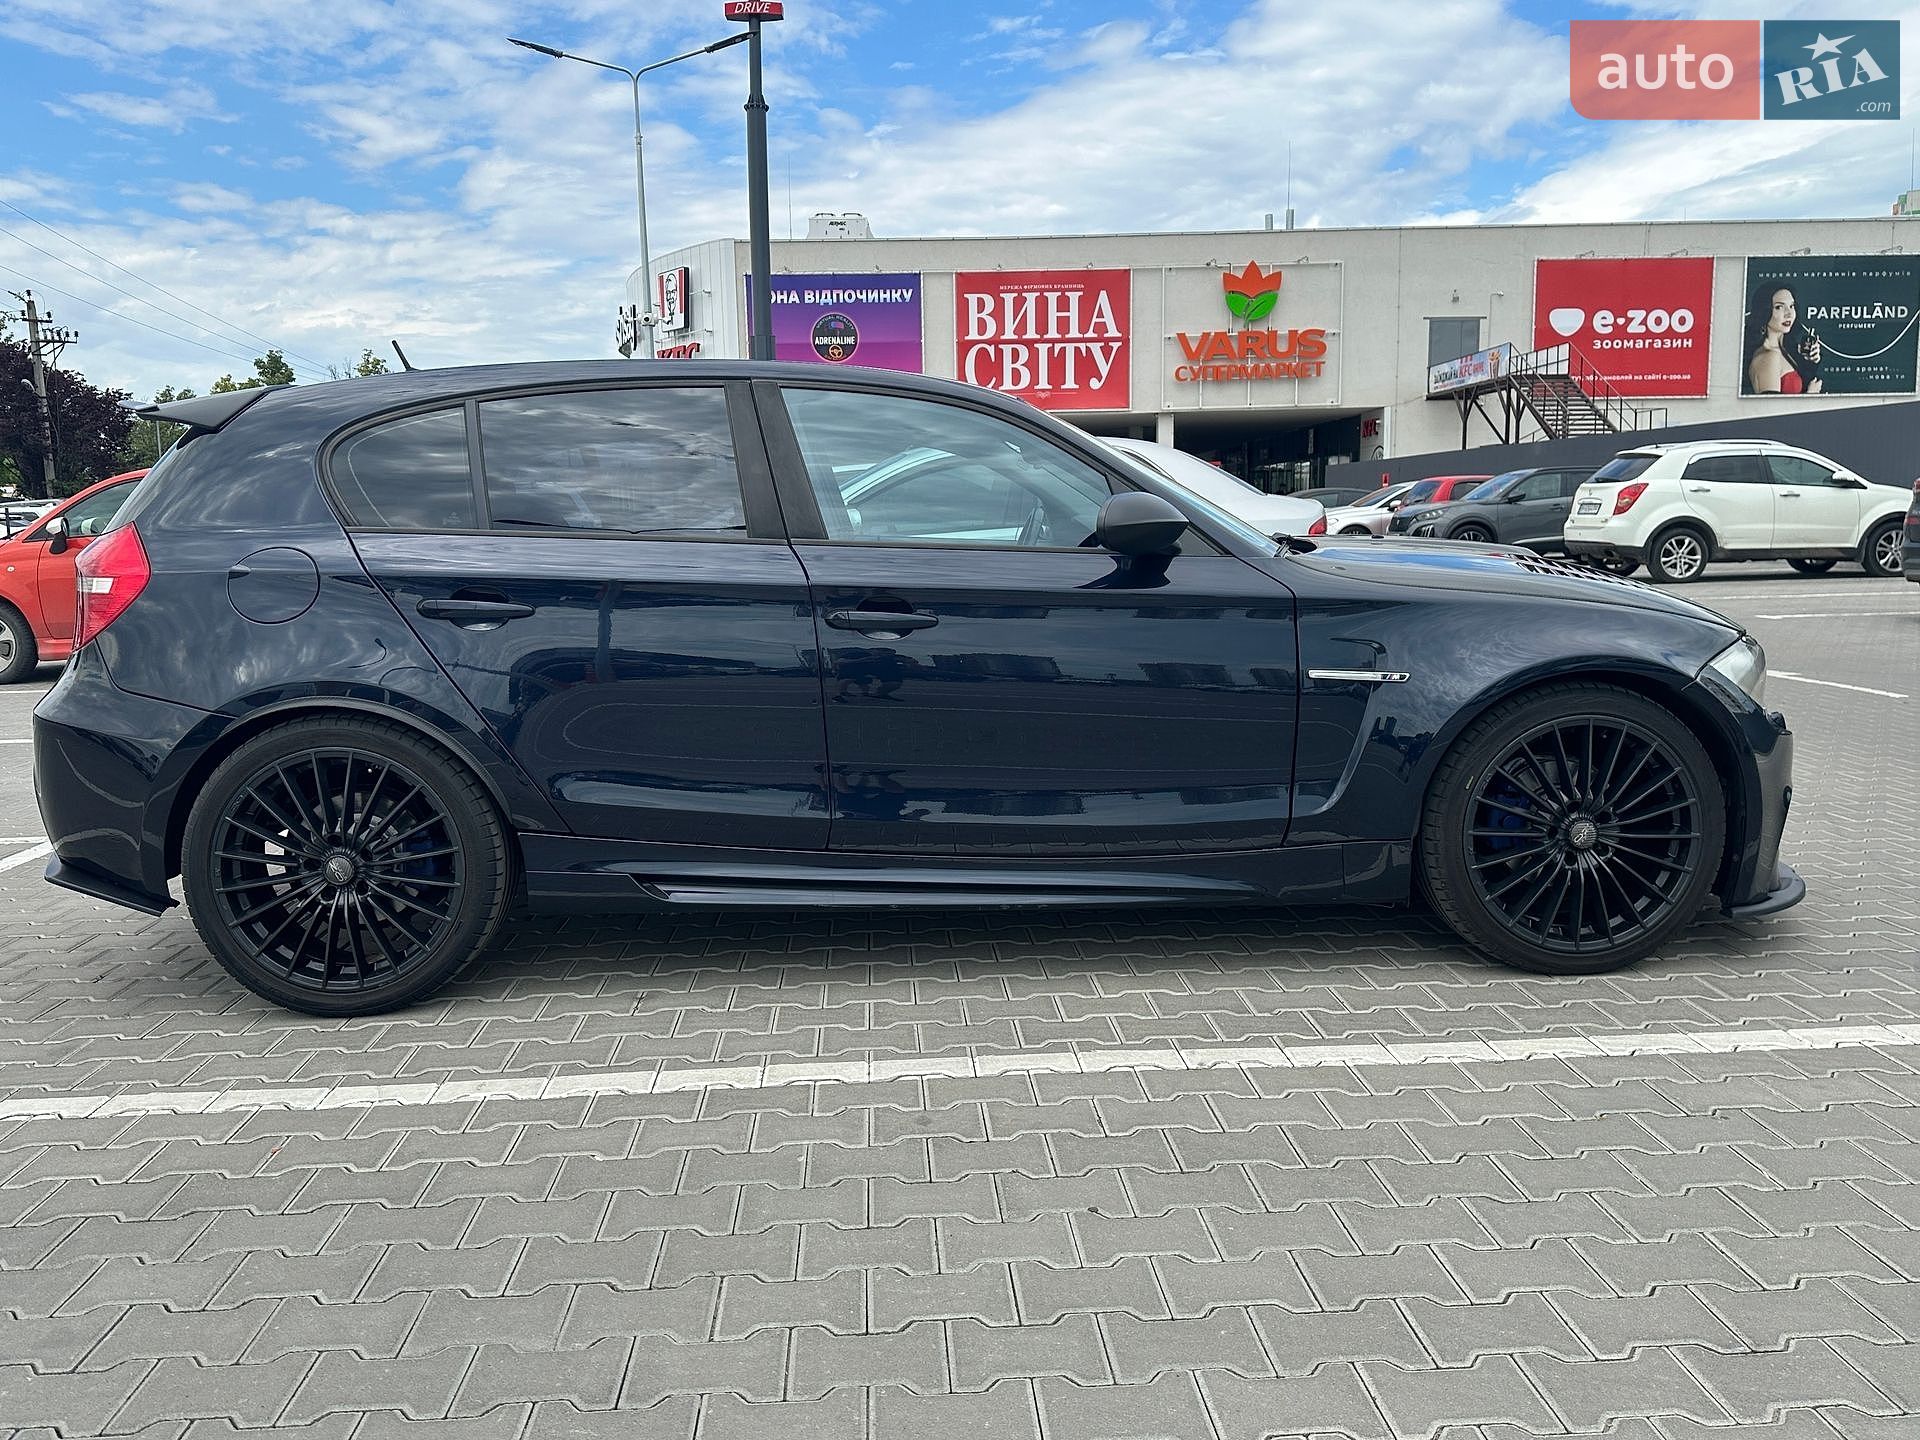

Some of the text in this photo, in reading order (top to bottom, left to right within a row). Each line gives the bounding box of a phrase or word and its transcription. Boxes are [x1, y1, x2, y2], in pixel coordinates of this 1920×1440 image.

[734, 1, 771, 13] DRIVE
[804, 288, 913, 306] ВІДПОЧИНКУ
[963, 289, 1123, 341] ВИНА
[814, 336, 856, 345] ADRENALINE
[1175, 328, 1328, 361] VARUS
[1592, 338, 1693, 349] зоомагазин
[964, 341, 1123, 391] СВІТУ
[1174, 360, 1326, 382] СУПЕРМАРКЕТ
